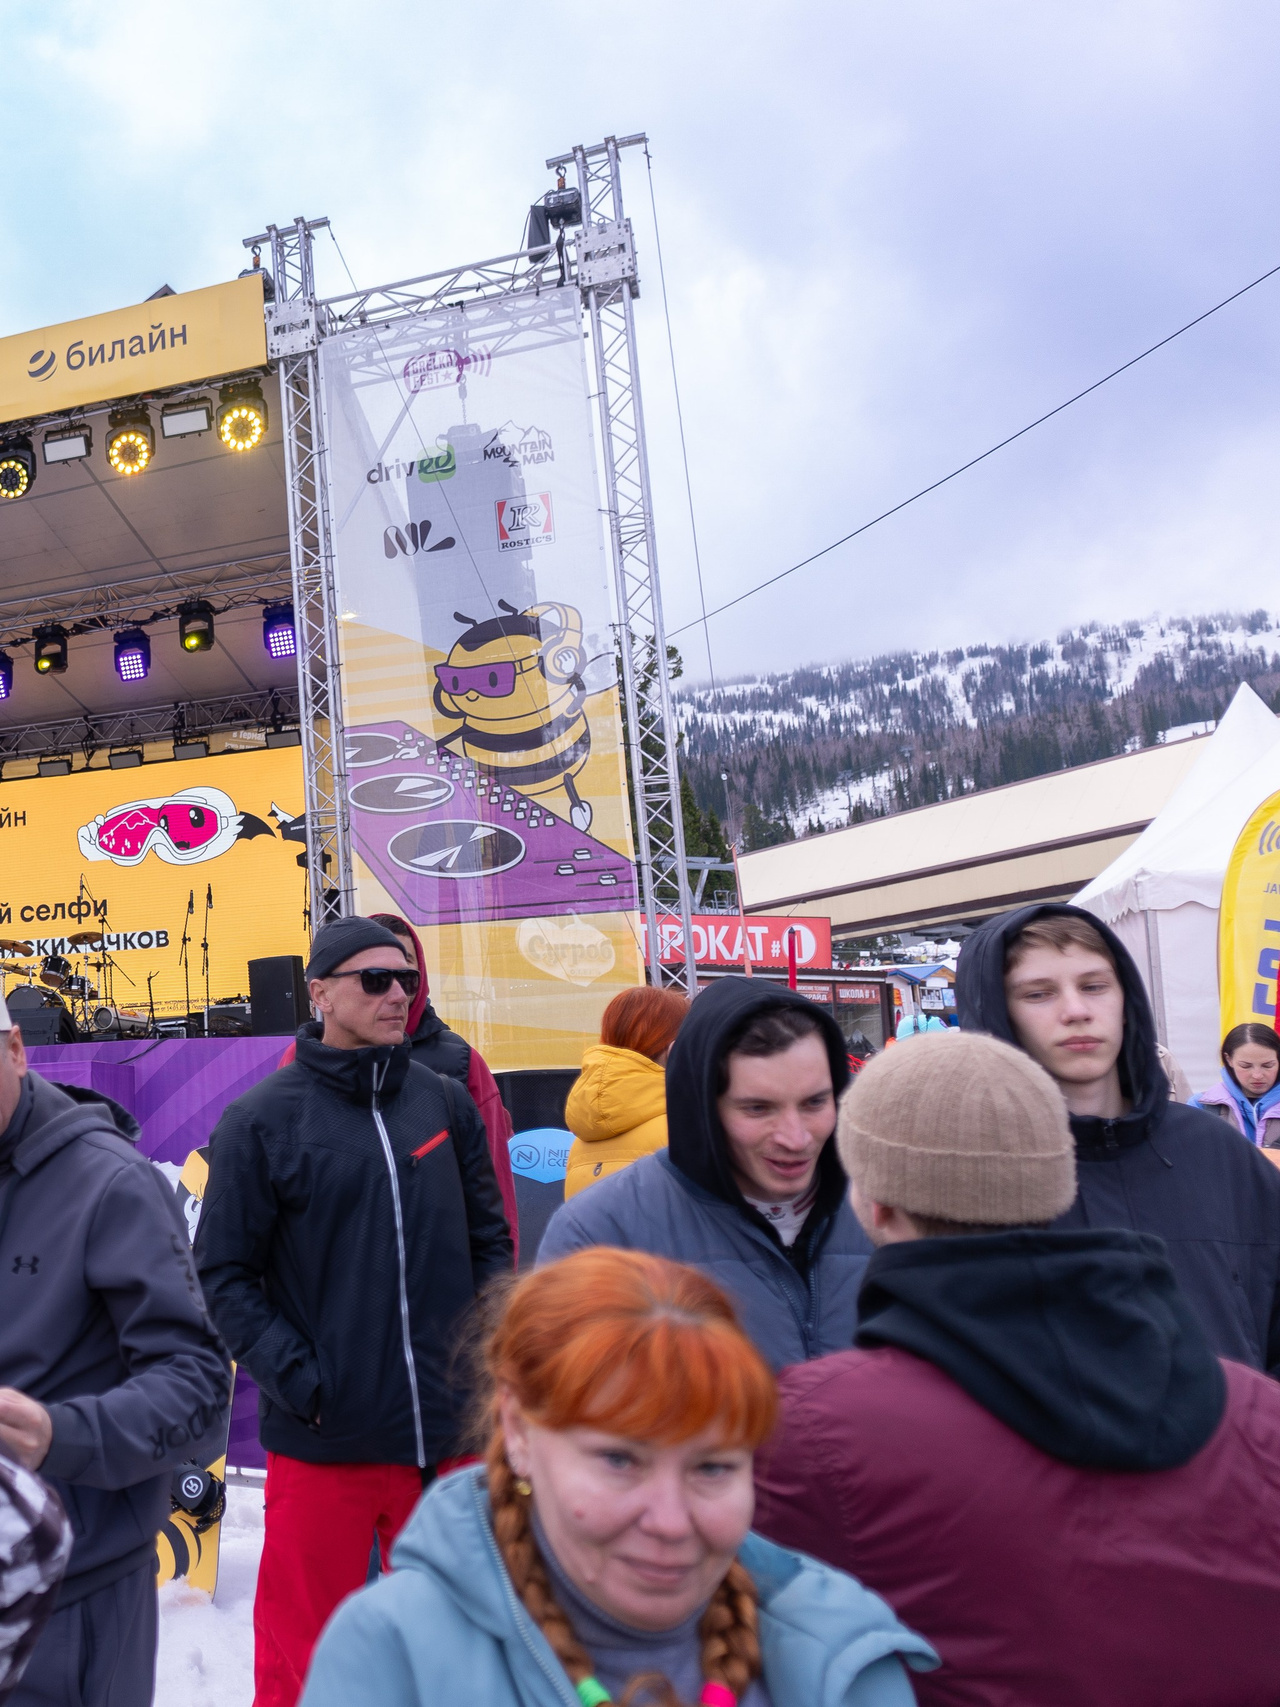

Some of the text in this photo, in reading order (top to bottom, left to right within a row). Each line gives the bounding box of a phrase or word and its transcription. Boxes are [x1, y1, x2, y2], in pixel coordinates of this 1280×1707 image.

[66, 322, 187, 371] билайн
[412, 353, 454, 375] GRELKA
[413, 371, 440, 389] FEST
[483, 439, 552, 461] MOUNTAIN
[522, 450, 555, 466] MAN
[366, 451, 456, 484] drivee
[501, 534, 553, 550] ROSTIC'S
[20, 895, 108, 925] селфи
[528, 935, 613, 967] Сугроб
[640, 923, 769, 962] ПРОКАТ
[771, 940, 781, 958] #
[839, 988, 864, 999] ШКОЛА
